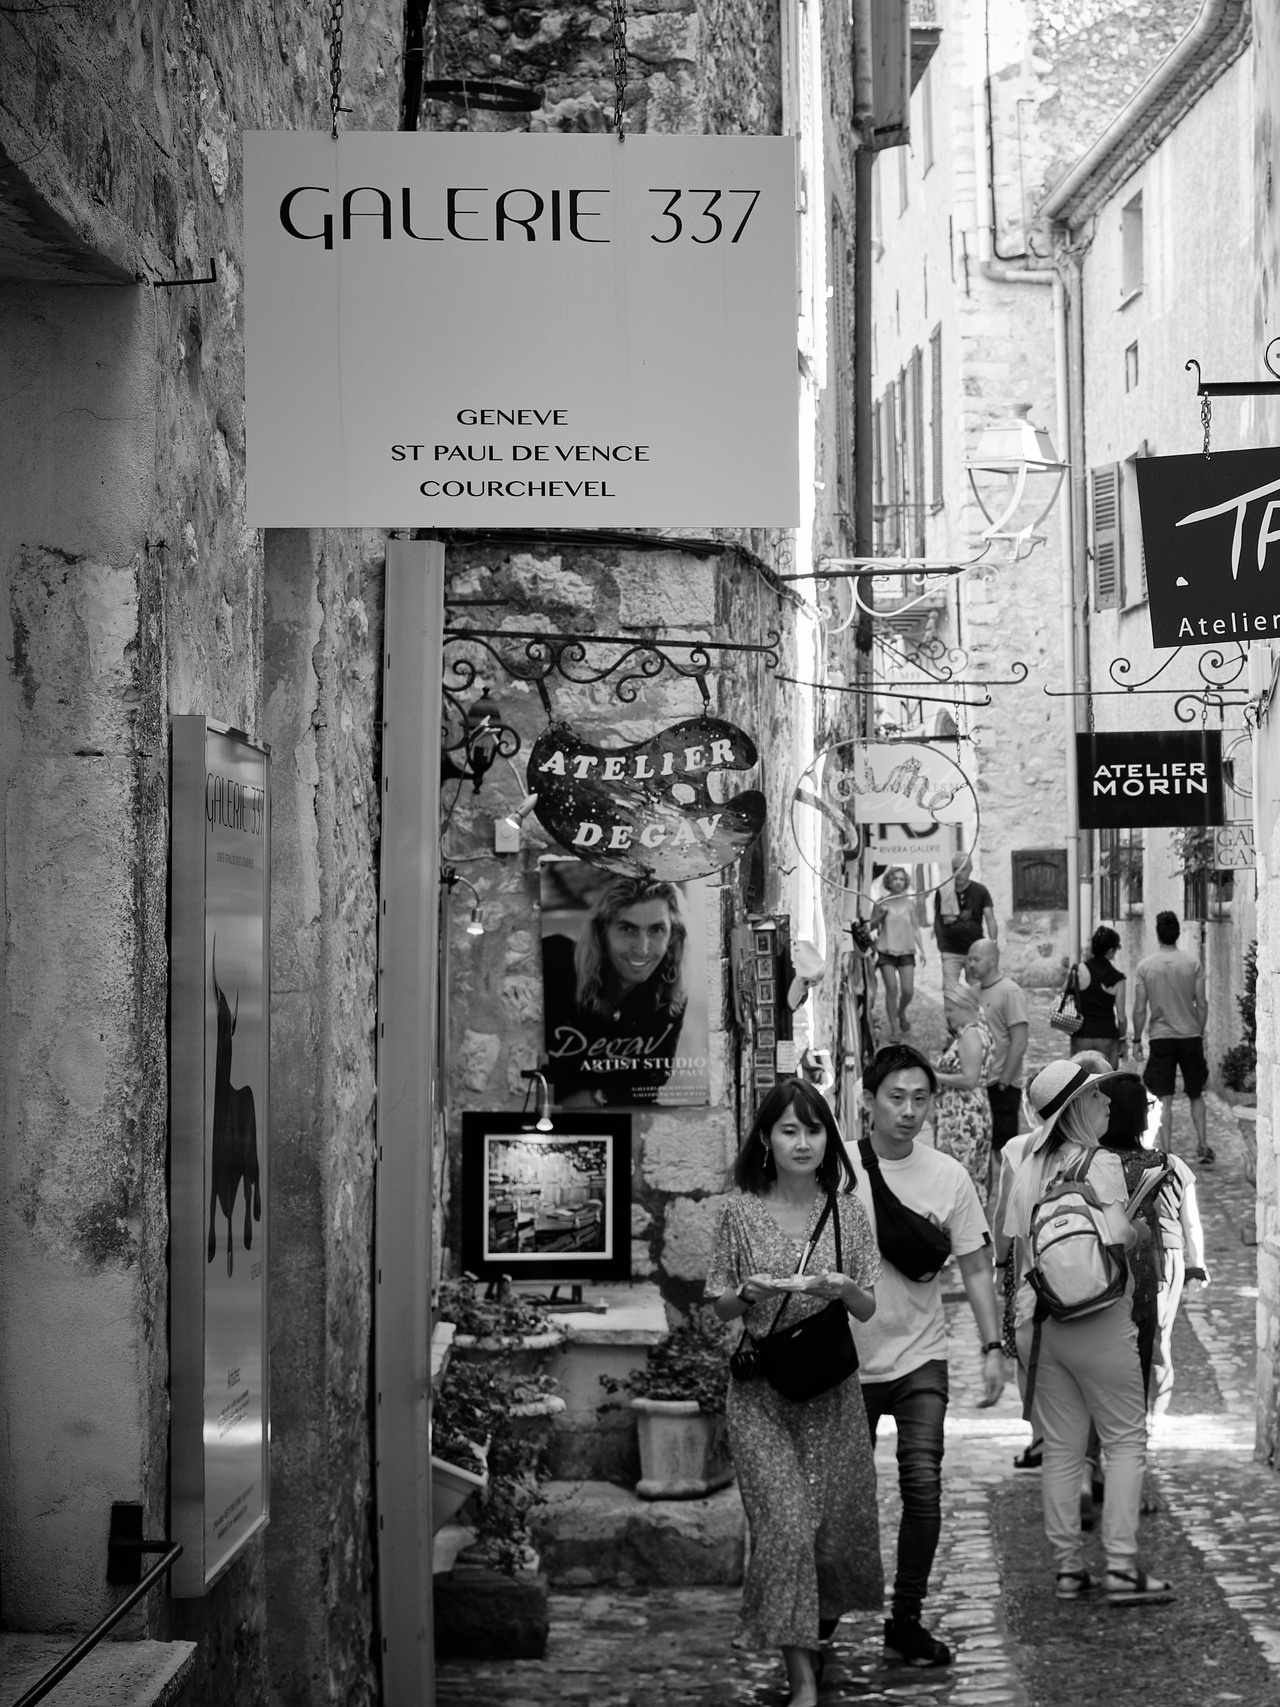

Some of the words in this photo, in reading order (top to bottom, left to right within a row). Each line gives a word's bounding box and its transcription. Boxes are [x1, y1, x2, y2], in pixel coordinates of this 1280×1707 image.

[280, 187, 611, 250] GALERIE
[649, 188, 761, 244] 337
[456, 409, 568, 426] GENEVE
[391, 445, 425, 462] ST
[434, 445, 503, 462] PAUL
[512, 445, 550, 461] DE
[554, 445, 650, 462] VENCE
[419, 480, 616, 497] COURCHEVEL
[539, 738, 736, 780] ATELIER
[1094, 762, 1206, 779] ATELIER
[1093, 778, 1208, 797] MORIN
[206, 772, 248, 833] GALERIE
[572, 814, 722, 850] DEGAV
[910, 845, 941, 854] GALERIE
[580, 1057, 641, 1072] ARTIST
[643, 1056, 707, 1070] STUDIO
